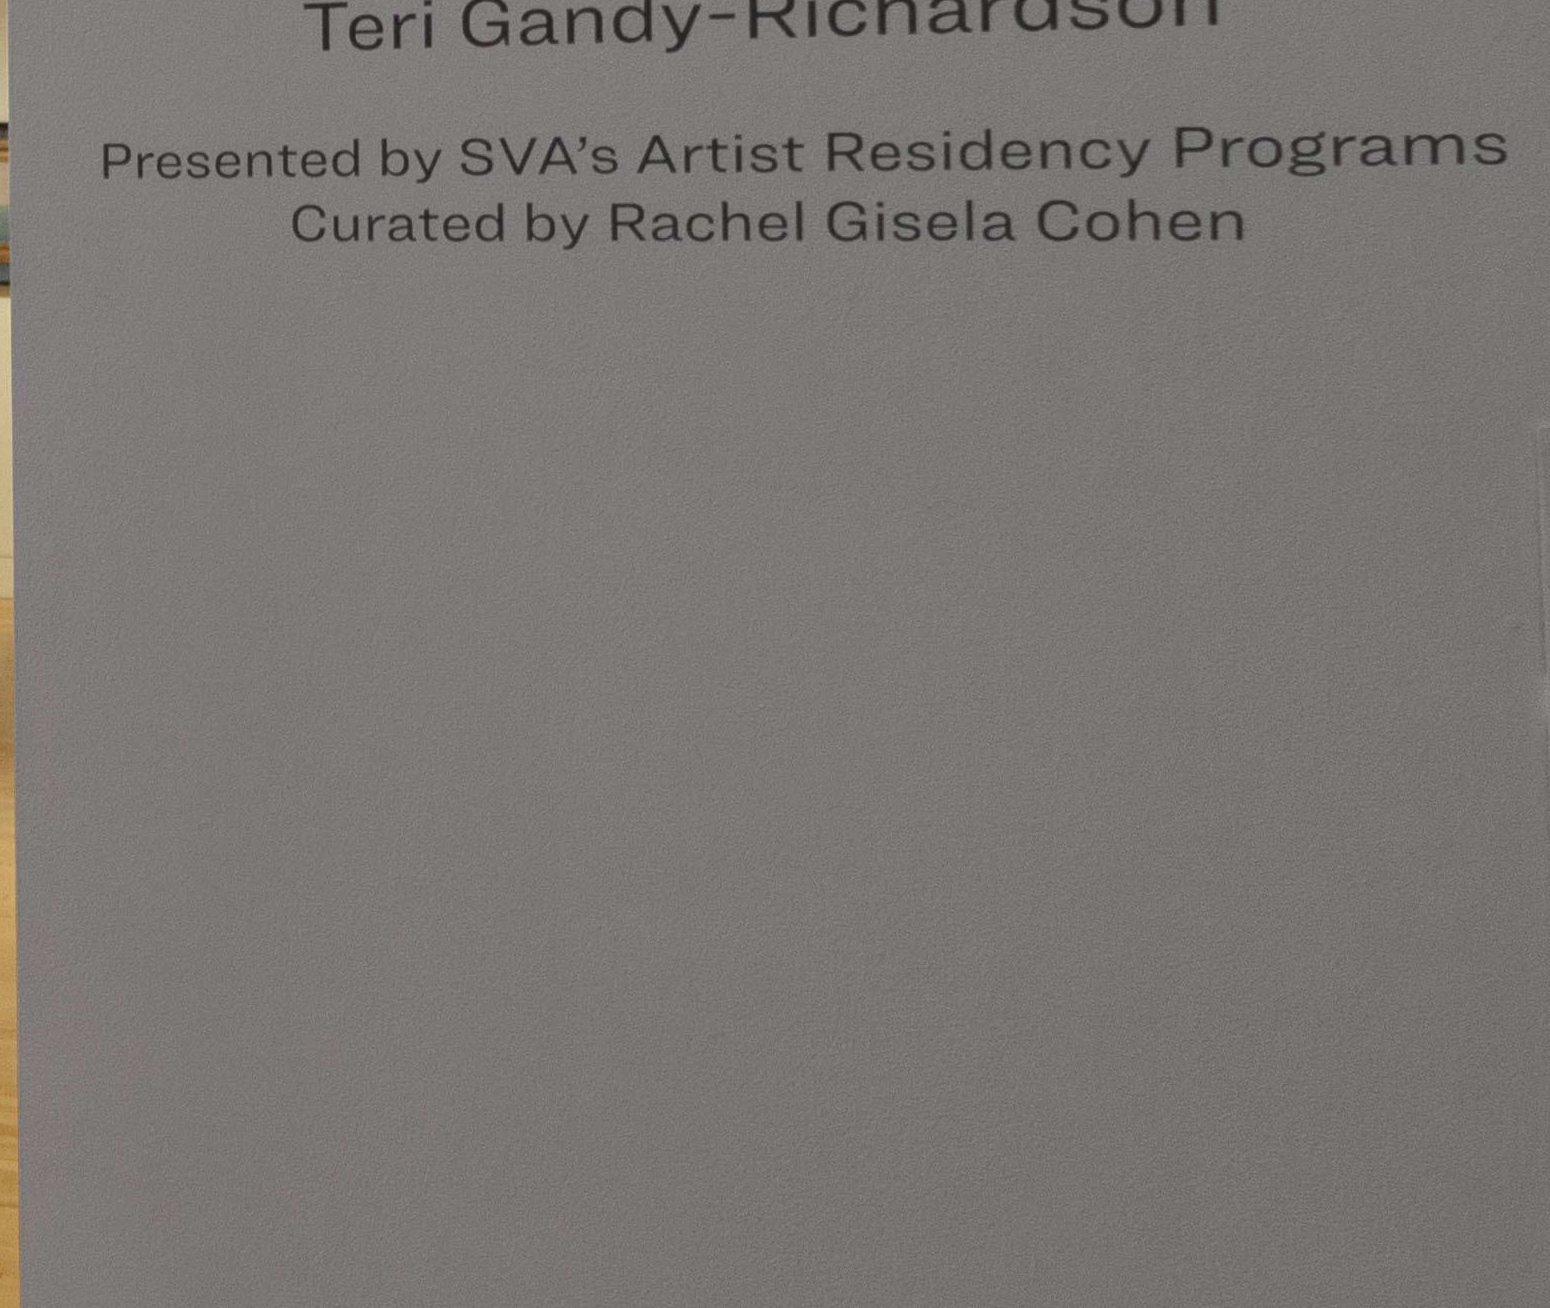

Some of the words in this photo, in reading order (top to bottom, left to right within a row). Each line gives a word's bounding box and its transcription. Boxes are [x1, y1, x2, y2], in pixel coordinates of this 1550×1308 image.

[101, 137, 362, 181] Presented
[379, 136, 443, 185] by
[459, 134, 620, 178] SVA’s
[636, 132, 805, 175] Artist
[825, 127, 1152, 180] Residency
[1173, 124, 1509, 179] Programs
[290, 201, 506, 244] Curated
[524, 200, 591, 252] by
[609, 199, 806, 244] Rachel
[825, 198, 1017, 244] Gisela
[1035, 197, 1246, 244] Cohen
